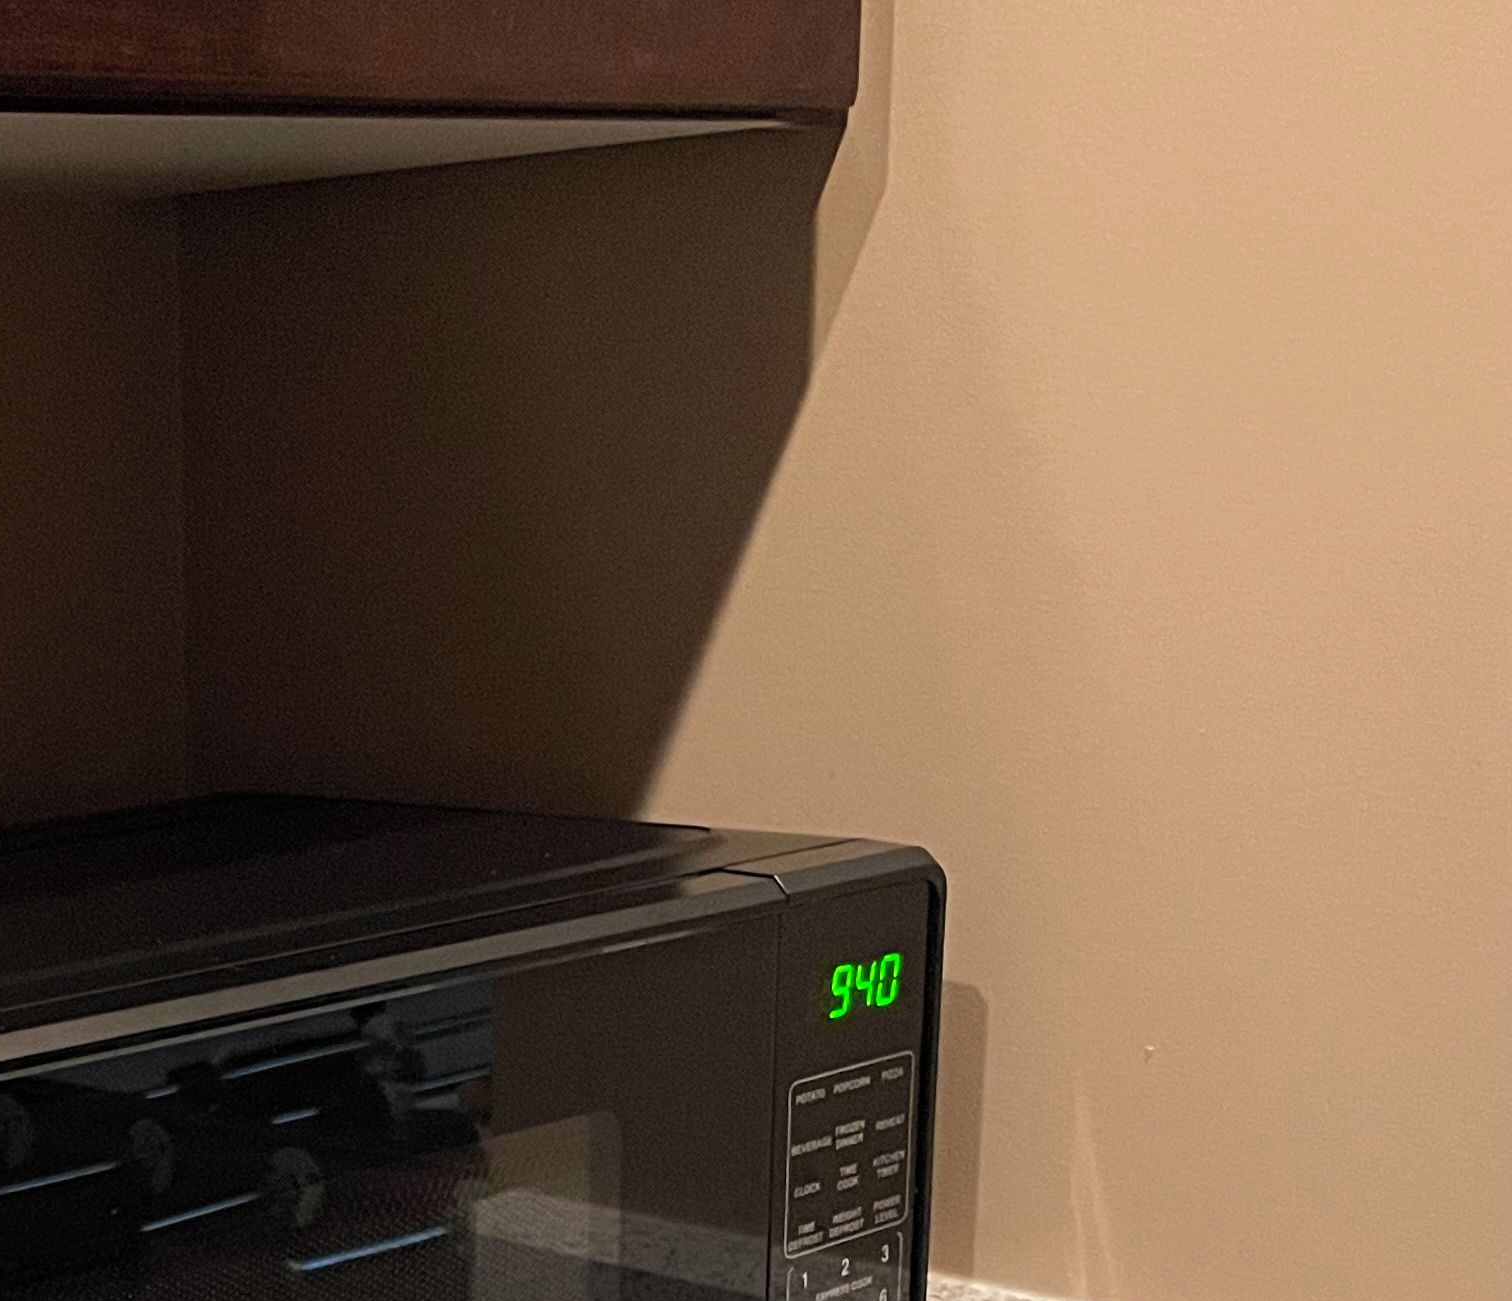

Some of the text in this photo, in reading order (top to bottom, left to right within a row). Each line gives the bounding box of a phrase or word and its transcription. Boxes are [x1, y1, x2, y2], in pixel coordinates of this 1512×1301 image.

[829, 953, 901, 1019] 940
[833, 1076, 871, 1094] POPCORN
[793, 1182, 820, 1198] CLOCK
[881, 1244, 889, 1262] 3
[841, 1258, 850, 1277] 2
[802, 1271, 808, 1288] 1
